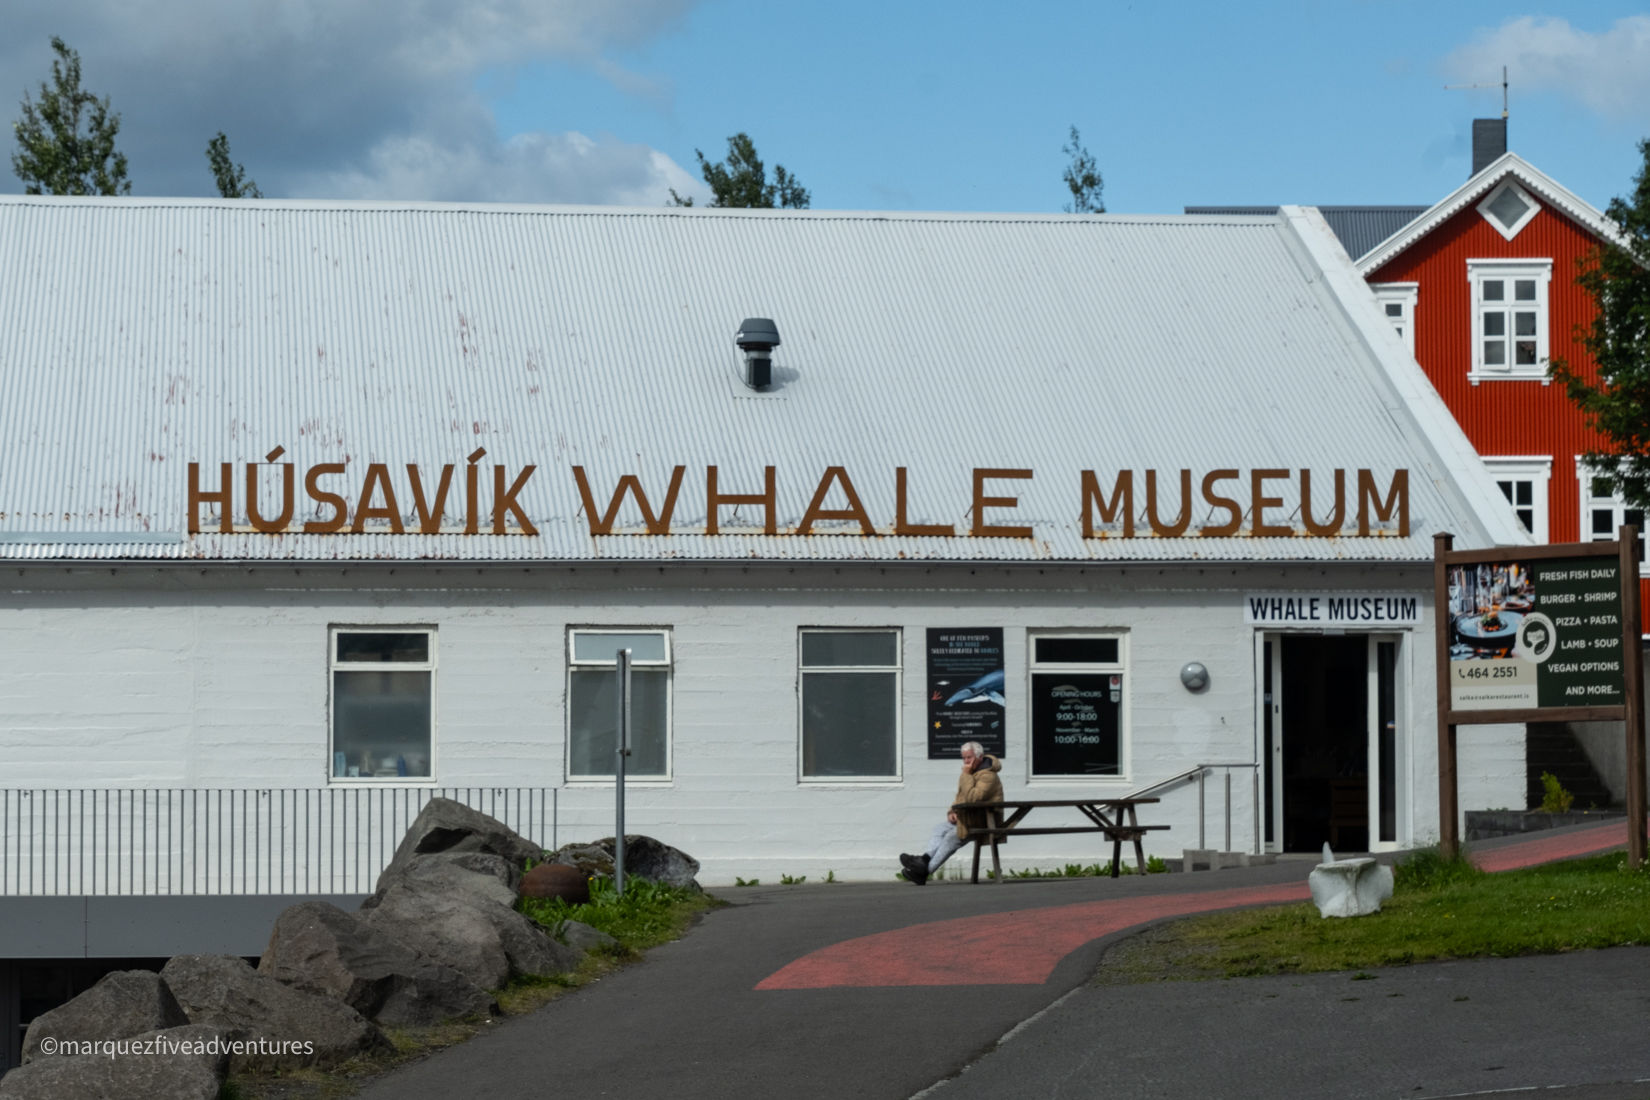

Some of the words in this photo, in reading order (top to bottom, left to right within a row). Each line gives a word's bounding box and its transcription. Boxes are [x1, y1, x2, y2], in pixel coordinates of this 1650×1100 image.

[188, 444, 539, 535] HÚSAVÍK
[571, 464, 1034, 537] WHALE
[1081, 468, 1410, 538] MUSEUM
[1540, 571, 1568, 581] FRESH
[1569, 570, 1588, 580] FISH
[1591, 568, 1616, 579] DAILY
[1540, 594, 1576, 604] BURGER
[1584, 592, 1617, 603] SHRIMP
[1250, 597, 1320, 621] WHALE
[1328, 597, 1417, 621] MUSEUM
[1556, 616, 1581, 626] PIZZA
[1590, 615, 1618, 626] PASTA
[1561, 640, 1586, 649] LAMB
[1594, 638, 1619, 648] SOUP
[1467, 666, 1489, 679] 464
[1493, 666, 1517, 678] 2551
[1548, 663, 1578, 673] VEGAN
[1580, 661, 1619, 672] OPTIONS
[1080, 690, 1102, 698] HOURS
[1565, 686, 1585, 696] AND
